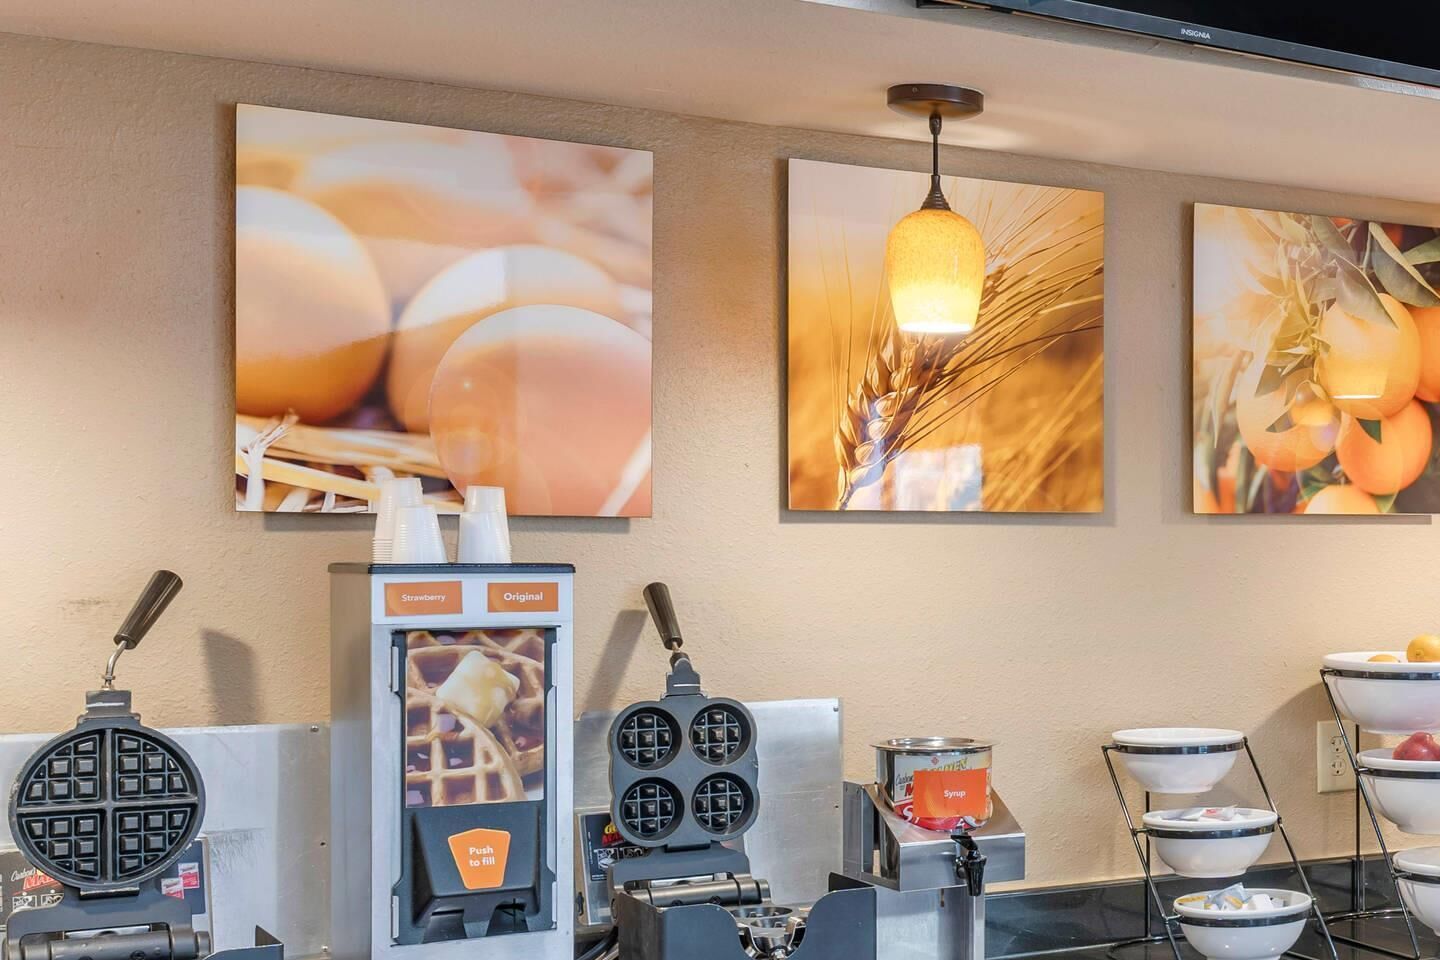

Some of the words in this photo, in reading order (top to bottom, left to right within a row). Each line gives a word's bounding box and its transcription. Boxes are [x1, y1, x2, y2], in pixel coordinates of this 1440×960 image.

[1180, 28, 1211, 39] INSIGNIA
[401, 594, 446, 602] Strawberry
[503, 591, 544, 603] Original
[943, 789, 967, 799] Syrup
[469, 845, 494, 855] Push
[470, 859, 481, 867] to
[482, 856, 496, 866] fill
